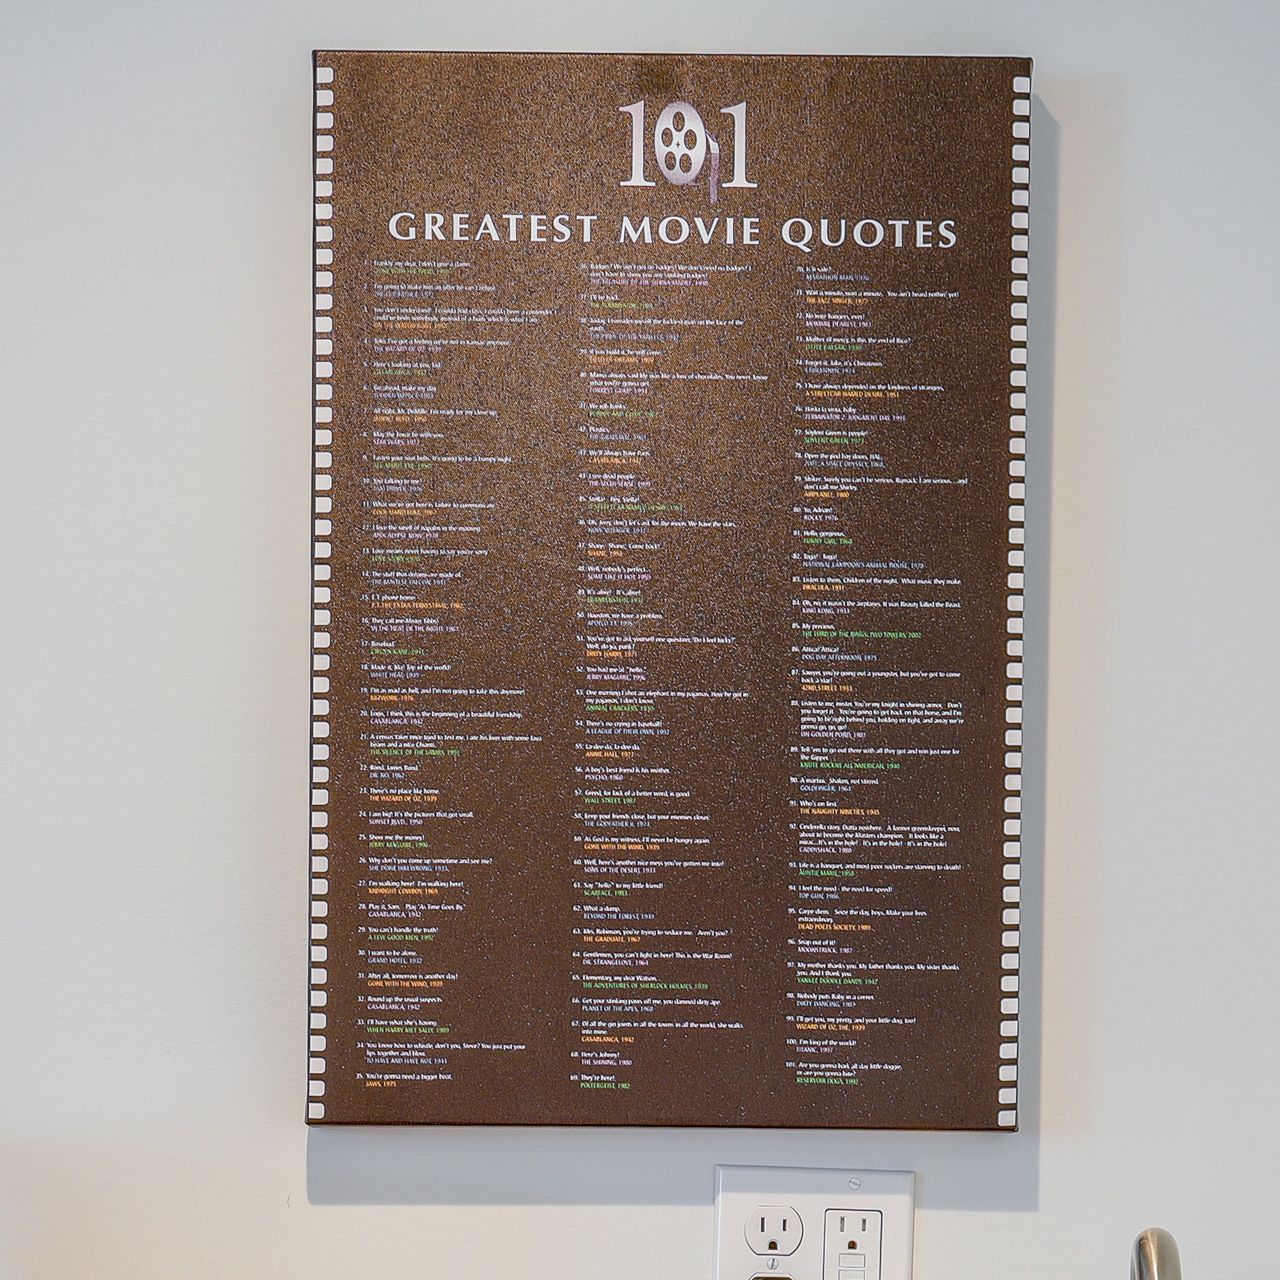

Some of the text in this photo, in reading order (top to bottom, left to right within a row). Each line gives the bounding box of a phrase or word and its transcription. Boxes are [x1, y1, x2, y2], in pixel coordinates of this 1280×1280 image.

[387, 210, 958, 253] GREATEST MOVIE QUOTES
